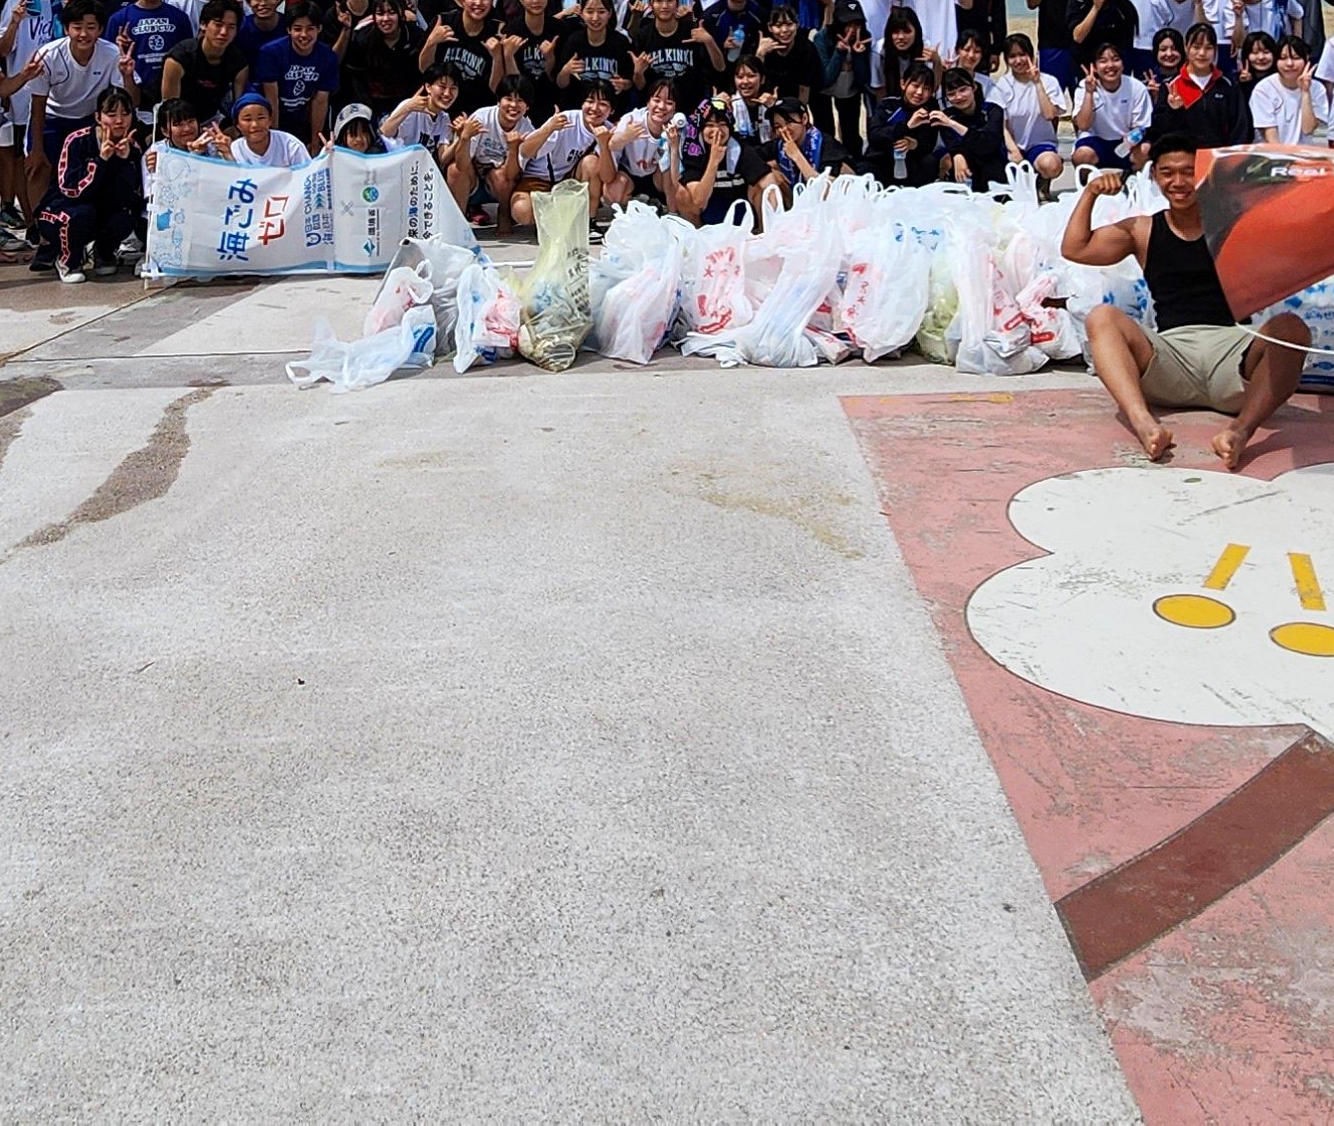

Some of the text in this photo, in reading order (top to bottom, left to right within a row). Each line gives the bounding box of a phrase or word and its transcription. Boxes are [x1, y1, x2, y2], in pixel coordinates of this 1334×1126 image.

[665, 48, 694, 67] KINKI
[217, 178, 259, 261] 海ごみ
[257, 196, 290, 246] ゼロ
